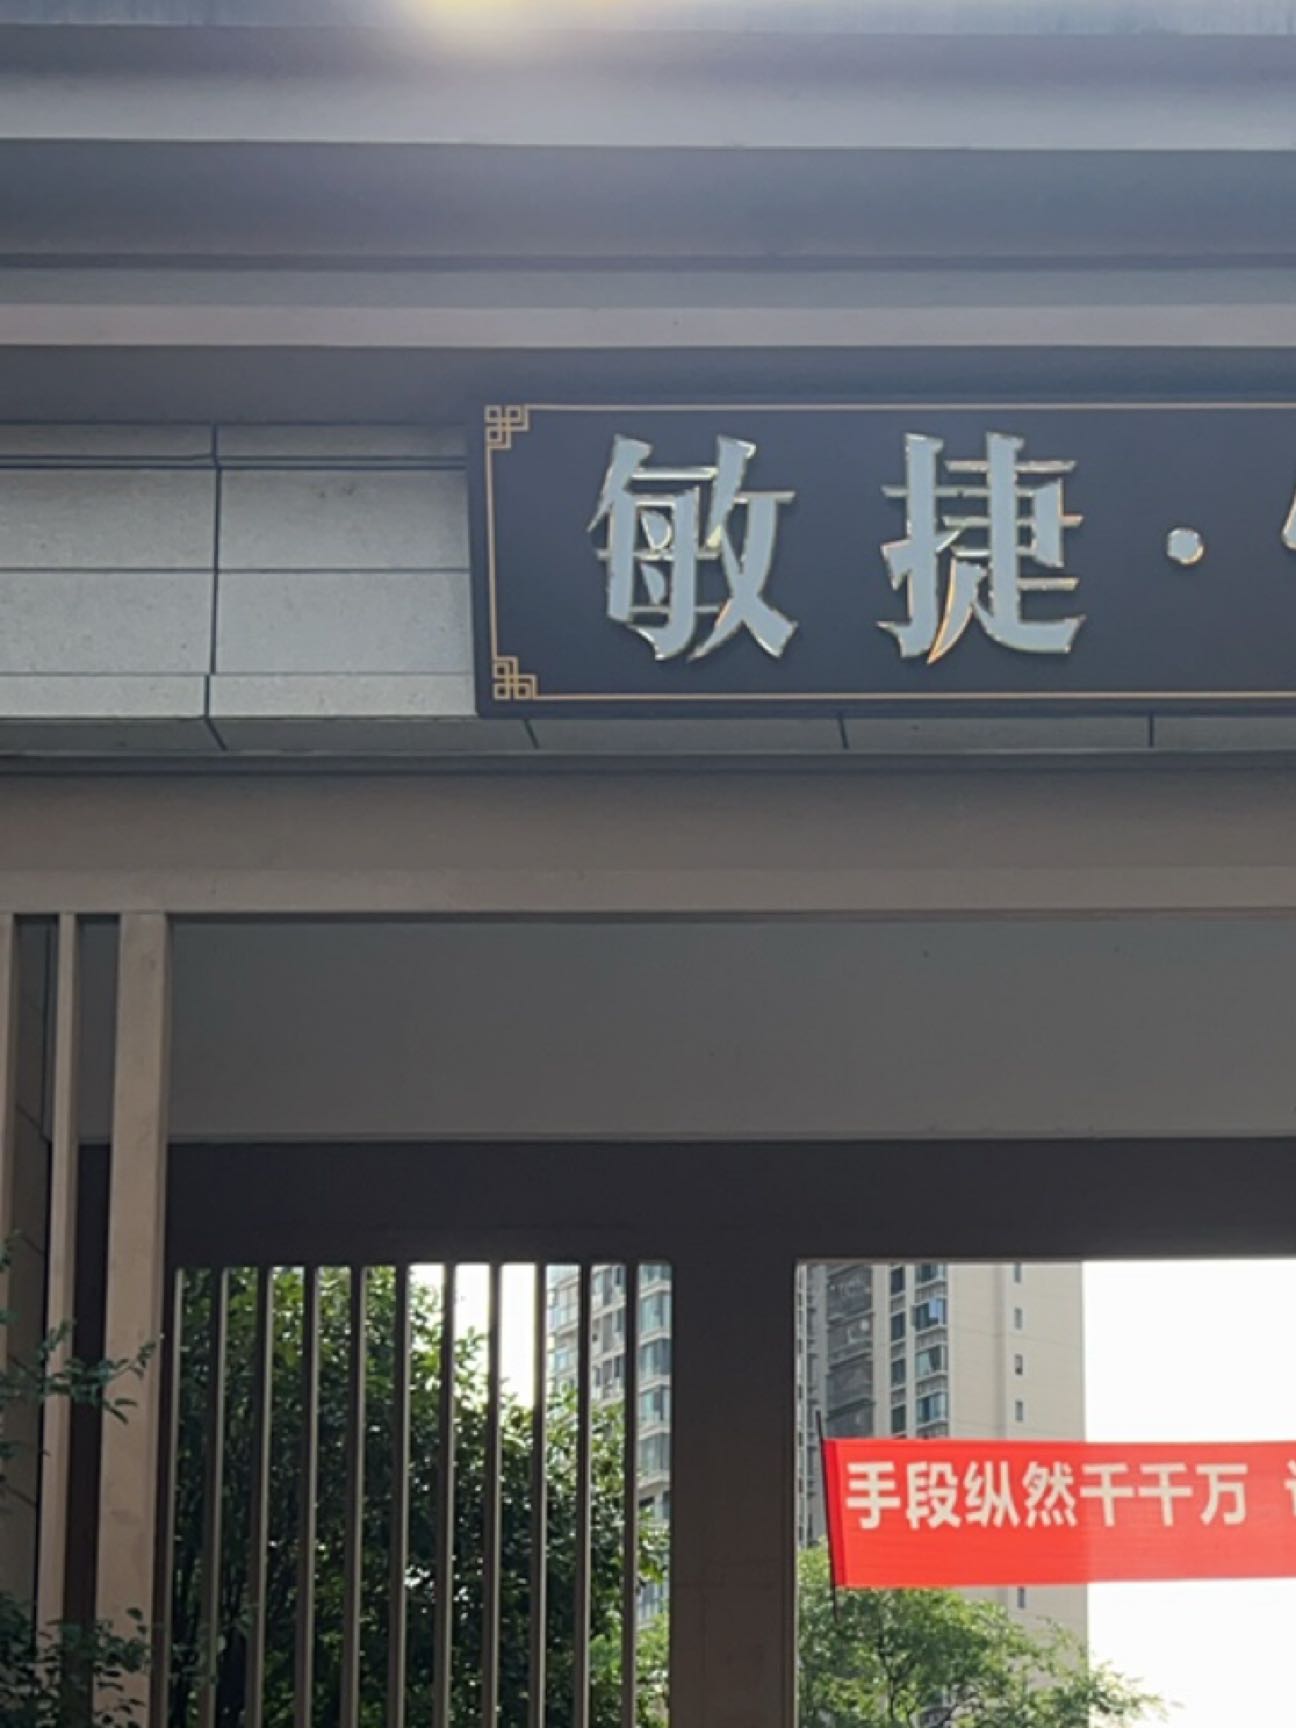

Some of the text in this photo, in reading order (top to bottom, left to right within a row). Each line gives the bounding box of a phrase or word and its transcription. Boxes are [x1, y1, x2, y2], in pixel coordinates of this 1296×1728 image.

[846, 1461, 1249, 1530] 手段纵然千千万
